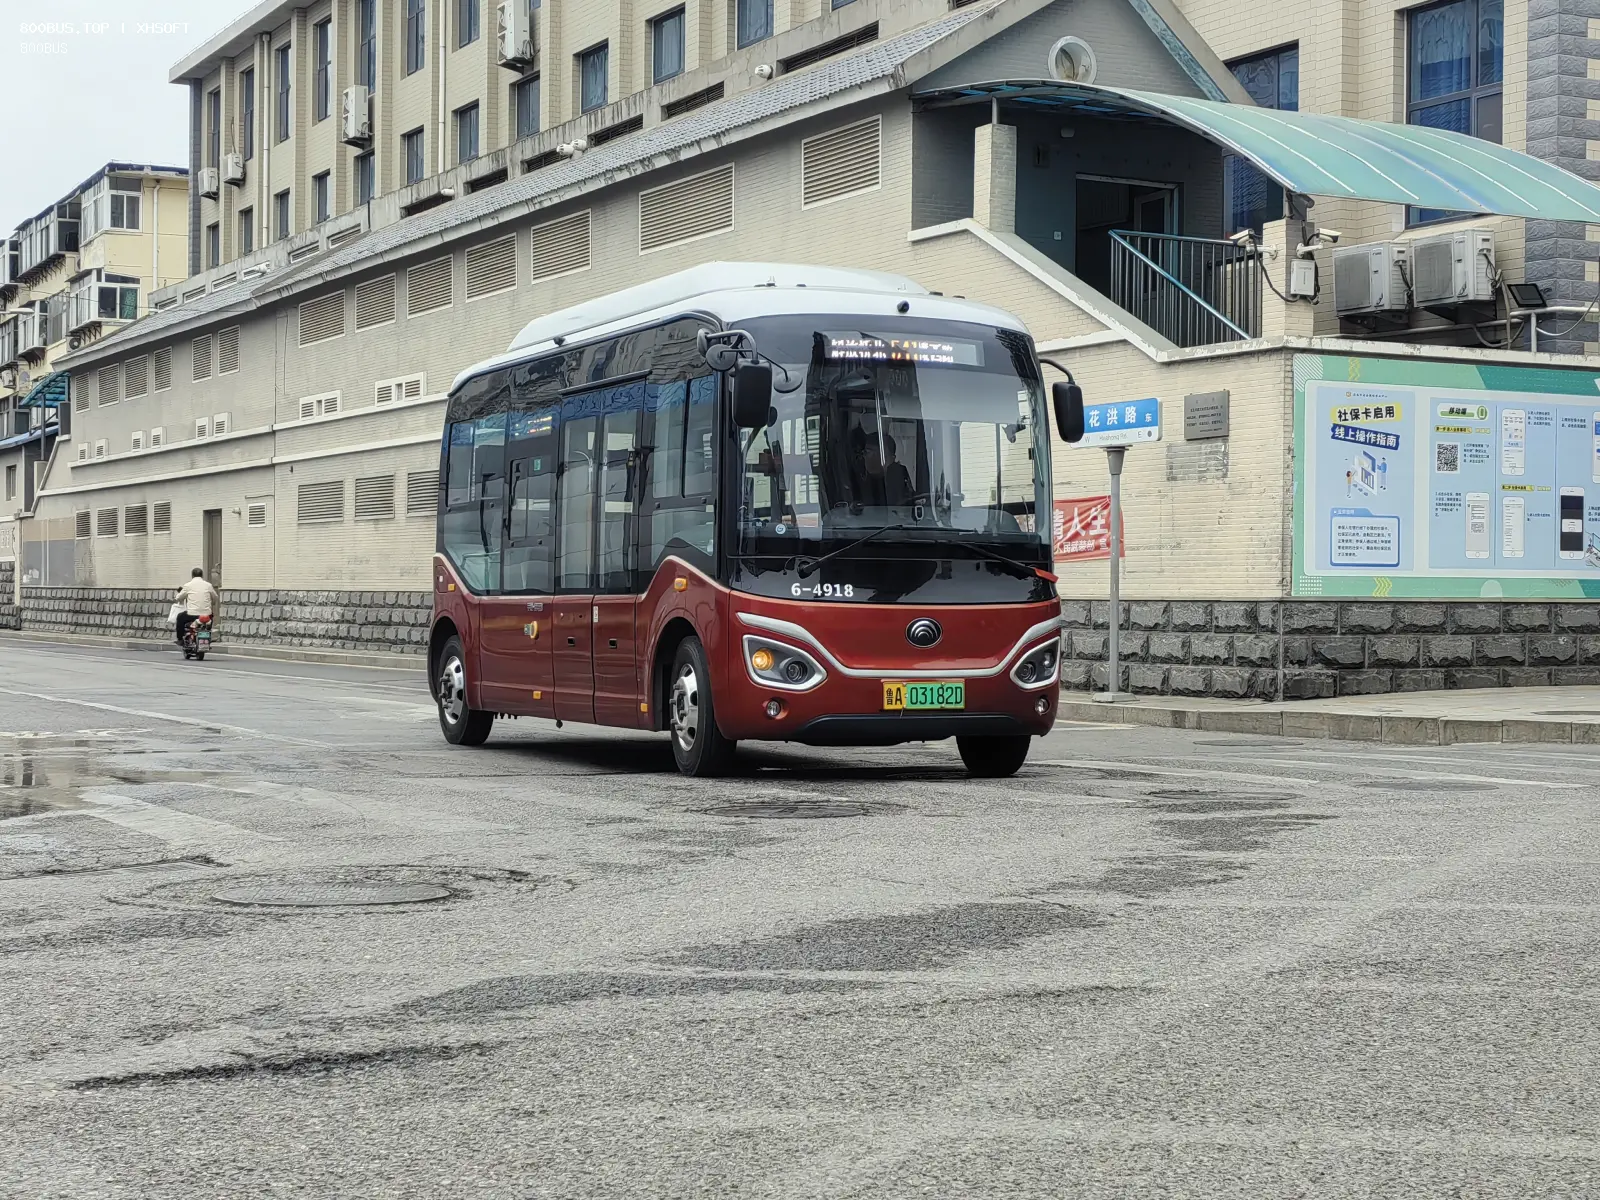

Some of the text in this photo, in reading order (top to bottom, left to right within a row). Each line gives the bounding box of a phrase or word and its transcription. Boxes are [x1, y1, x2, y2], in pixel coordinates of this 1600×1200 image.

[1088, 405, 1137, 428] 花洪路
[1337, 405, 1395, 422] 社保卡启用
[1137, 430, 1143, 438] E
[1334, 426, 1397, 447] 线上操作指南
[791, 582, 854, 598] 6-4918
